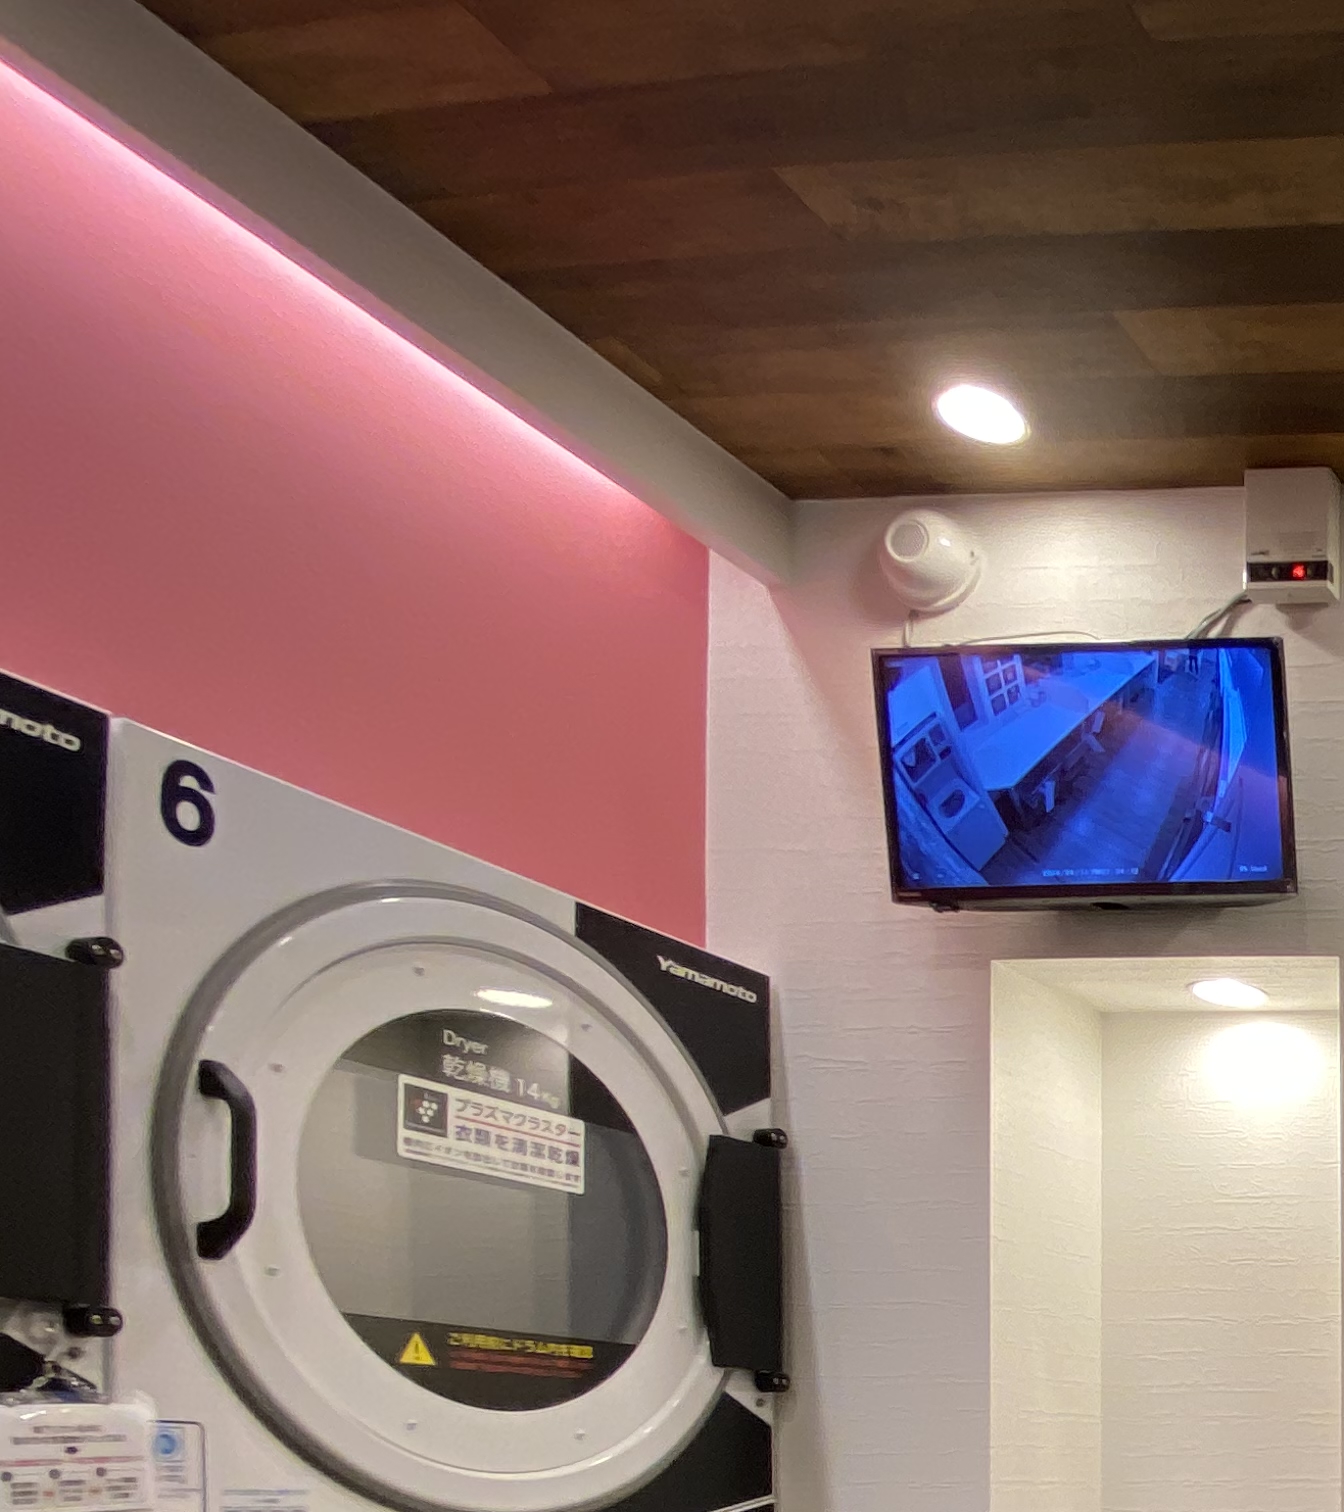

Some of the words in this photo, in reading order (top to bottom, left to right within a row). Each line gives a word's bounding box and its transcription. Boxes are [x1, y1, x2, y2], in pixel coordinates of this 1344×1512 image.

[160, 760, 216, 847] 6
[656, 954, 758, 1003] Yamamoto
[442, 1029, 489, 1056] Dryer
